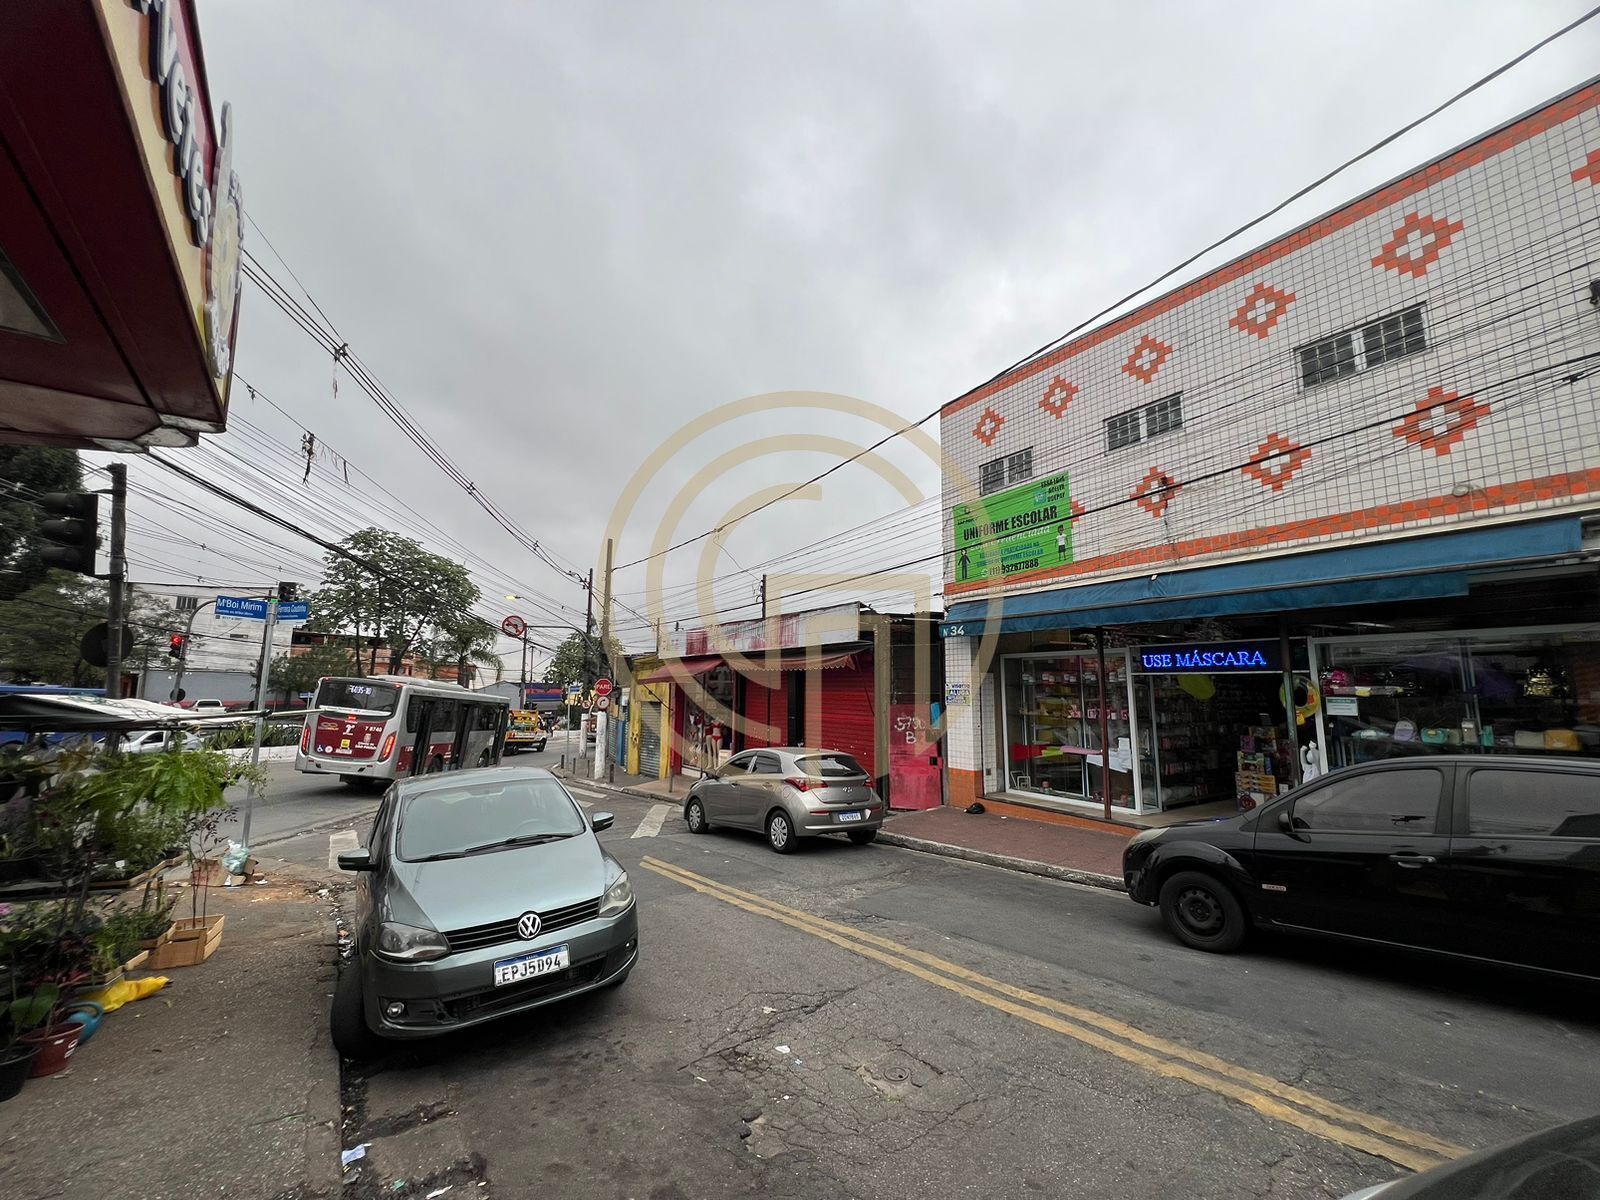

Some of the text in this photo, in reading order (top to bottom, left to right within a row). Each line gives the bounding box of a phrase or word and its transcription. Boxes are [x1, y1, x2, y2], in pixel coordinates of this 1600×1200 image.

[141, 0, 211, 248] vetes
[963, 505, 1058, 541] UNIFORME ESCOLAR
[216, 598, 262, 612] M'Boi Mirim
[950, 625, 965, 636] 34
[1142, 649, 1267, 668] USE MÁSCARA
[501, 954, 562, 983] EPJ5D94
